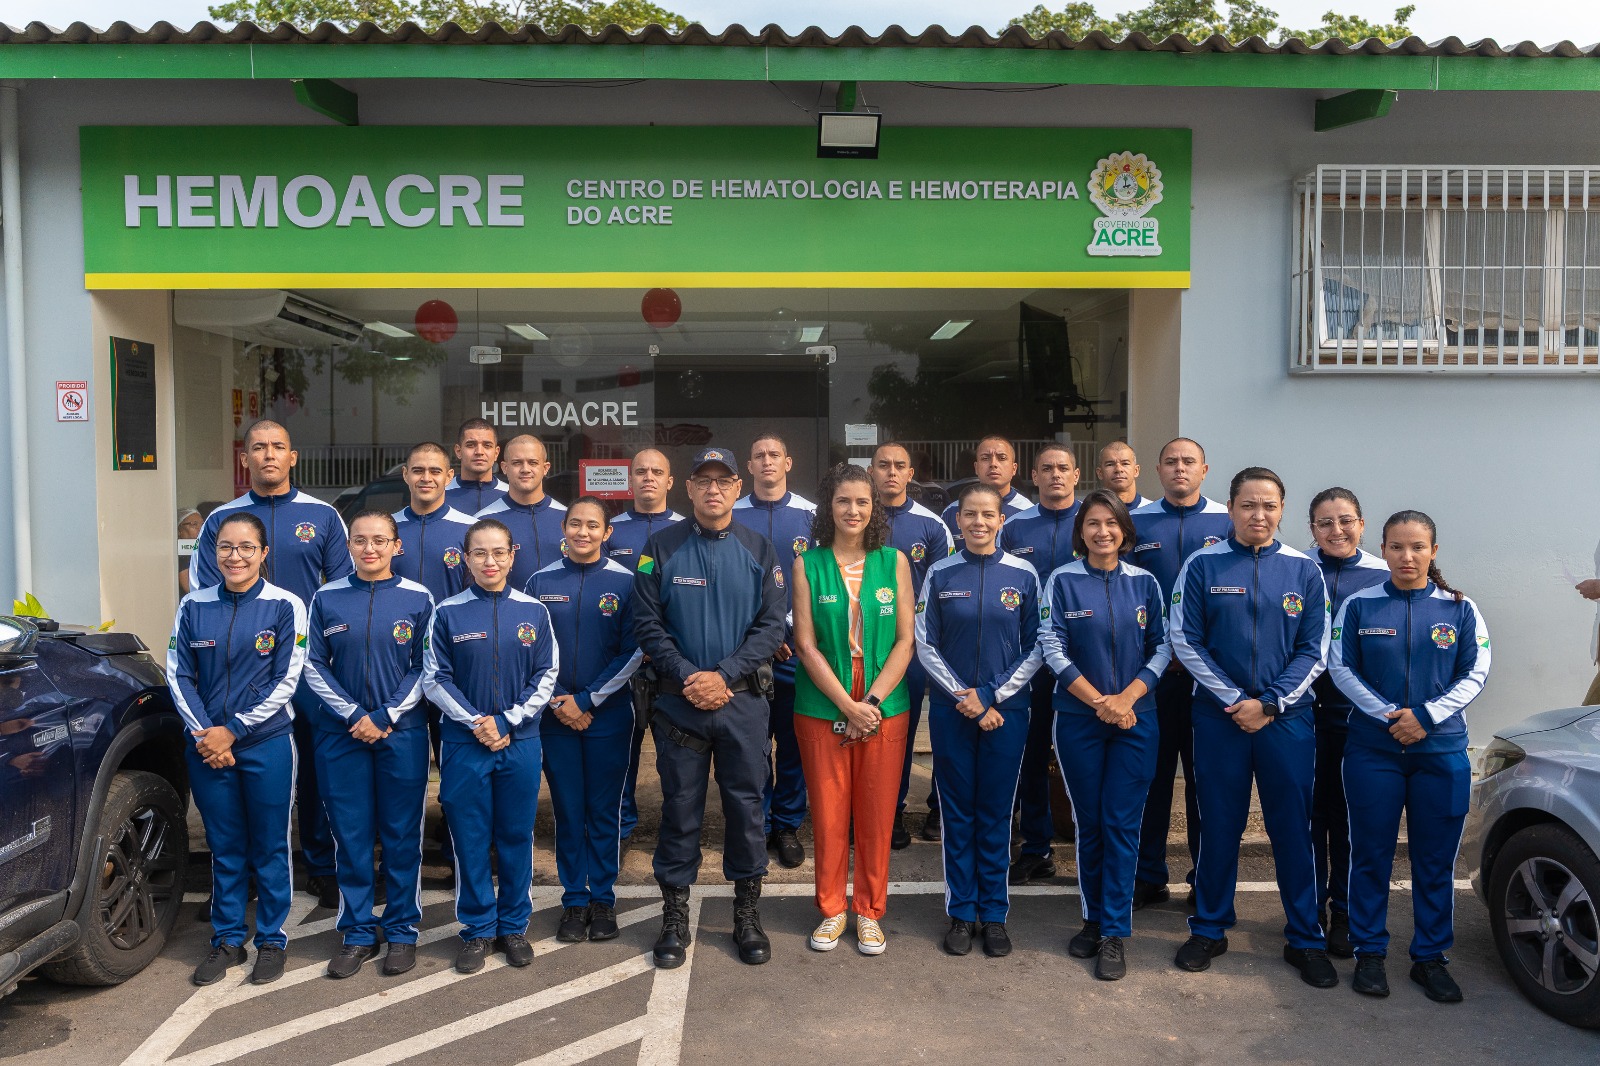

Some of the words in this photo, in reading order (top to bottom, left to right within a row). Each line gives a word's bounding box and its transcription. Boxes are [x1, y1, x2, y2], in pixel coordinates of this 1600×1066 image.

[123, 173, 526, 229] HEMOACRE
[566, 179, 665, 203] CENTRO
[671, 180, 704, 203] DE
[711, 179, 883, 204] HEMATOLOGIA
[889, 180, 903, 203] E
[910, 180, 1080, 204] HEMOTERAPIA
[566, 205, 602, 225] DO
[606, 205, 673, 225] ACRE
[1097, 220, 1140, 229] GOVERNO
[1142, 220, 1155, 229] DO
[1096, 229, 1155, 246] ACRE
[481, 401, 639, 427] HEMOACRE
